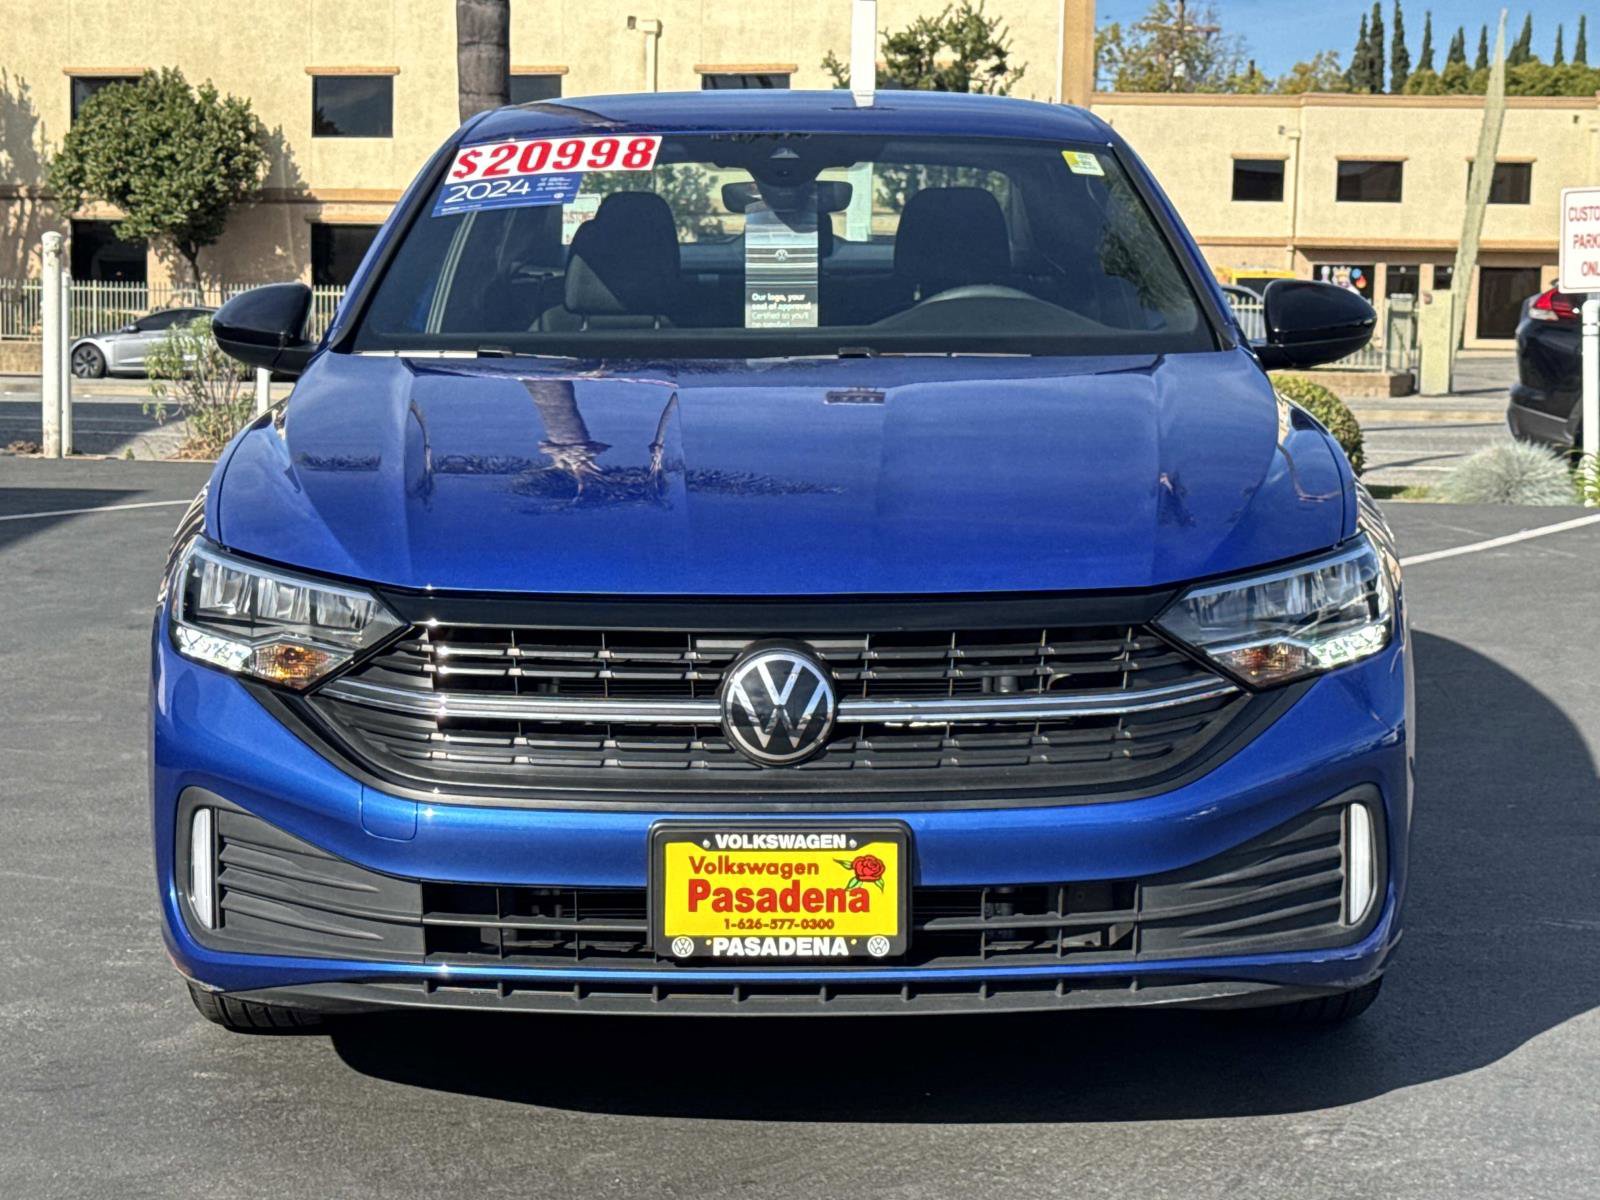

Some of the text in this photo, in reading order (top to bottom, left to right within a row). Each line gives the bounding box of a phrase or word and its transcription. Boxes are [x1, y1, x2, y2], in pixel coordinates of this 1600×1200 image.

[452, 138, 656, 179] $20998
[444, 178, 531, 204] 2024
[751, 292, 766, 301] Our
[787, 294, 805, 303] your
[715, 833, 847, 850] VOLKSWAGEN
[688, 855, 820, 879] Volkswagen
[688, 878, 870, 913] Pasadena
[723, 918, 835, 930] 1-626-577-0300
[712, 937, 849, 956] PASADENA
